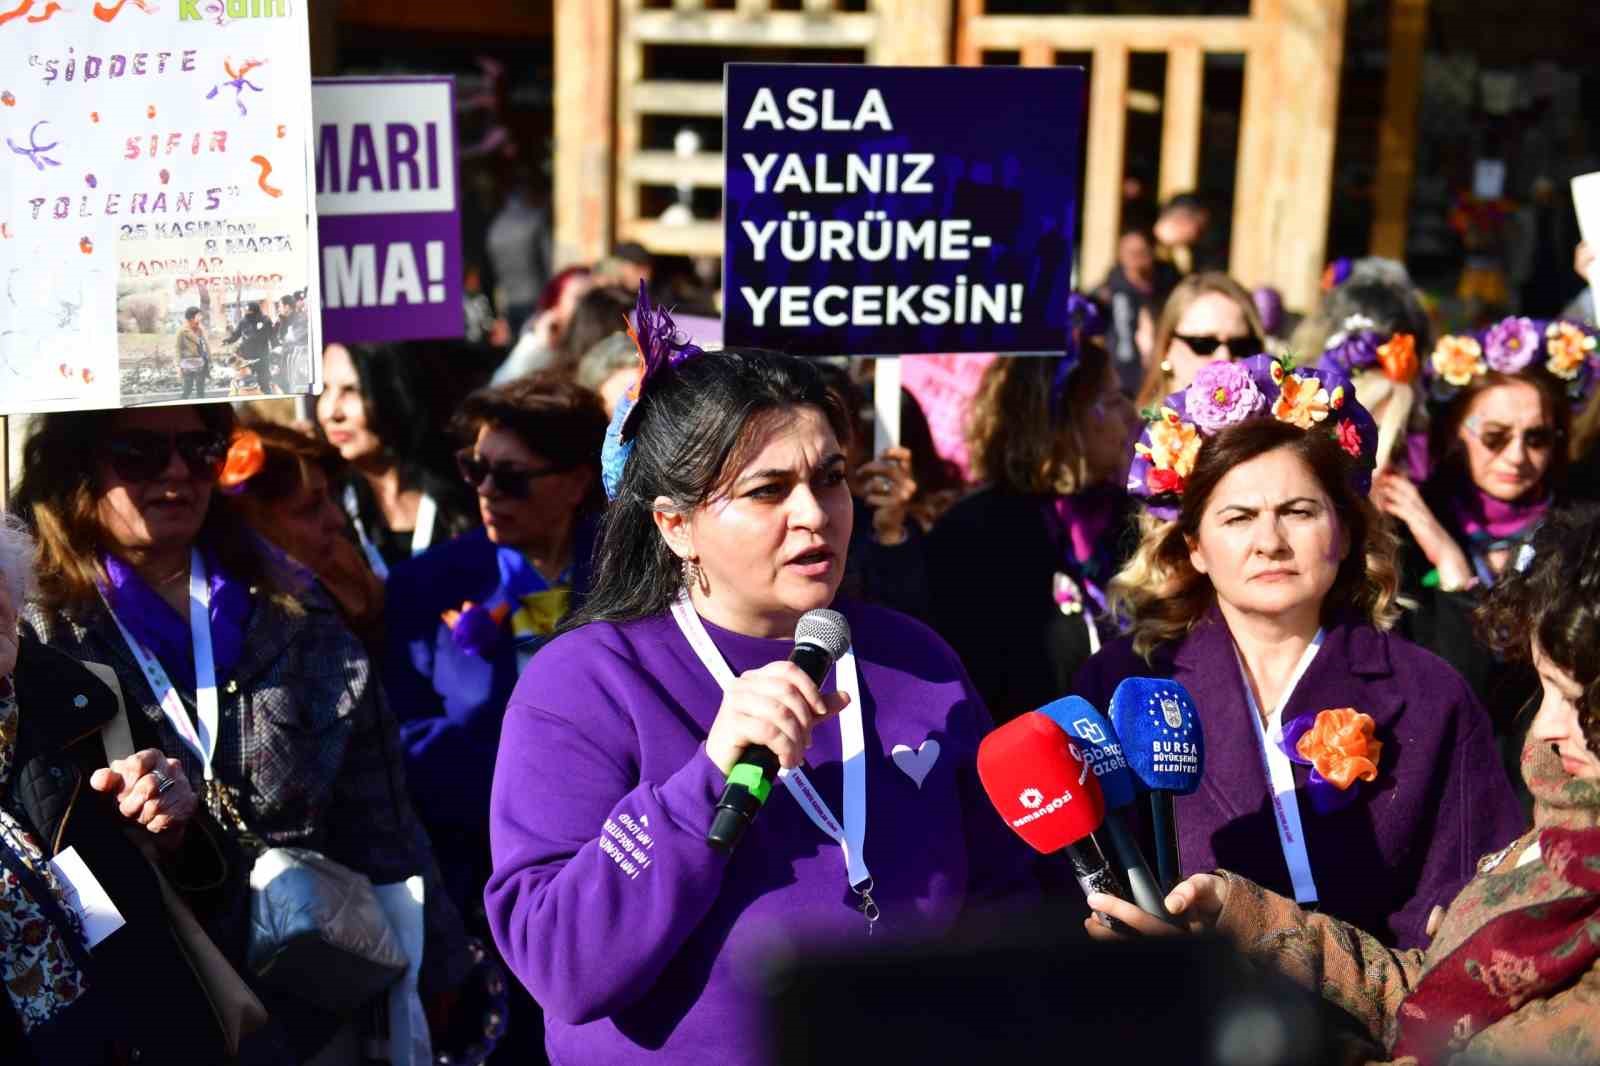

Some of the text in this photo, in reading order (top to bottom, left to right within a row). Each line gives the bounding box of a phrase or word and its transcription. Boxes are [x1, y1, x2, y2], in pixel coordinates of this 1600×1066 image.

[743, 87, 893, 131] ASLA
[124, 130, 229, 160] SIFIR
[742, 153, 935, 193] YALNIZ
[120, 223, 147, 240] 25
[741, 210, 992, 261] YÜRÜME-
[740, 275, 1024, 327] YECEKSİN!
[1153, 740, 1197, 754] BURSA
